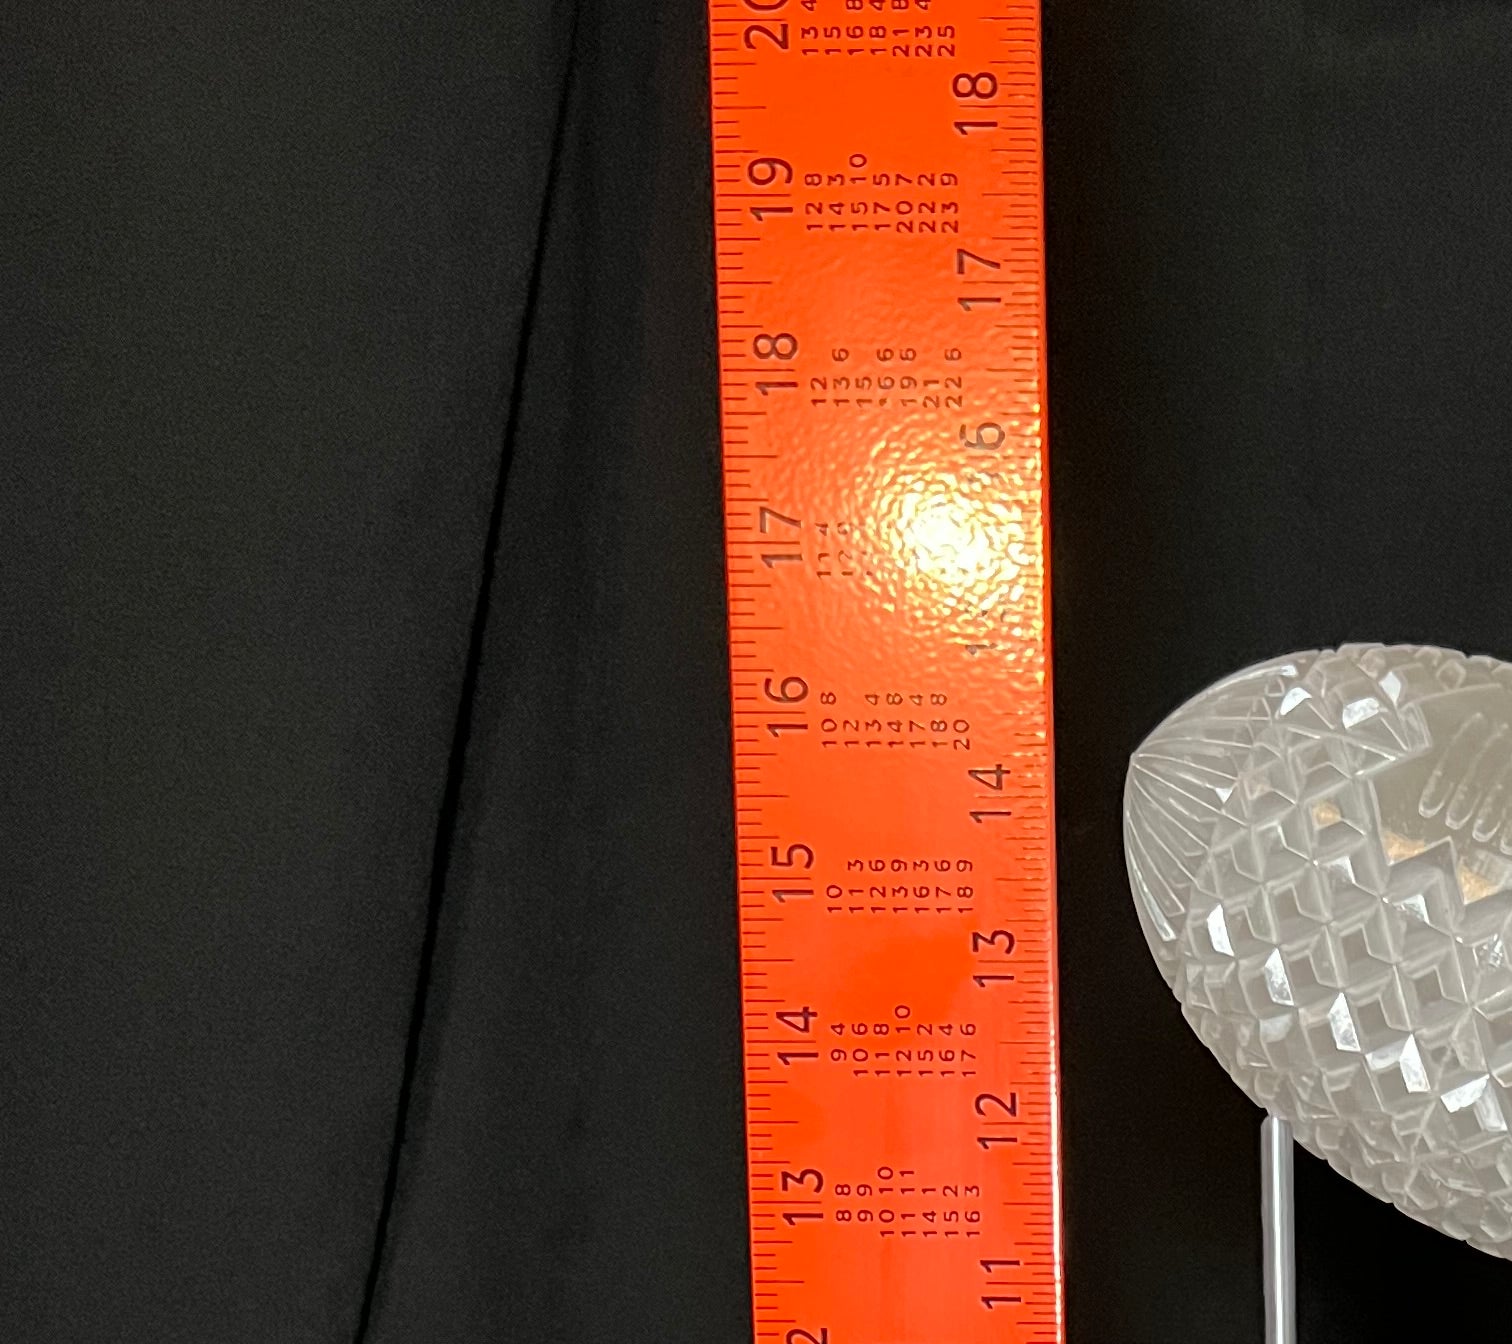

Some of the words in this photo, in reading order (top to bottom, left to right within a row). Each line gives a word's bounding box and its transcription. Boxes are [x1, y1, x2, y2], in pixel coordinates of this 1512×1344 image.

[953, 72, 998, 135] 18
[748, 158, 793, 221] 19
[957, 249, 1001, 311] 17
[753, 333, 798, 395] 18
[760, 507, 803, 568] 17
[764, 677, 808, 737] 16
[968, 764, 1012, 823] 14
[771, 844, 814, 902] 15
[972, 930, 1015, 987] 13
[776, 1007, 819, 1065] 14
[975, 1093, 1017, 1149] 12
[781, 1169, 823, 1225] 13
[835, 1184, 851, 1196] 8
[857, 1184, 872, 1196] 9
[878, 1167, 893, 1193] 10
[899, 1171, 915, 1194] 11
[943, 1186, 958, 1197] 2
[965, 1186, 979, 1197] 3
[836, 1210, 851, 1221] 8
[857, 1210, 873, 1222] 9
[879, 1210, 894, 1237] 10
[901, 1214, 916, 1237] 11
[922, 1211, 937, 1237] 14
[944, 1211, 958, 1237] 15
[965, 1211, 980, 1237] 16
[980, 1260, 1021, 1309] 11
